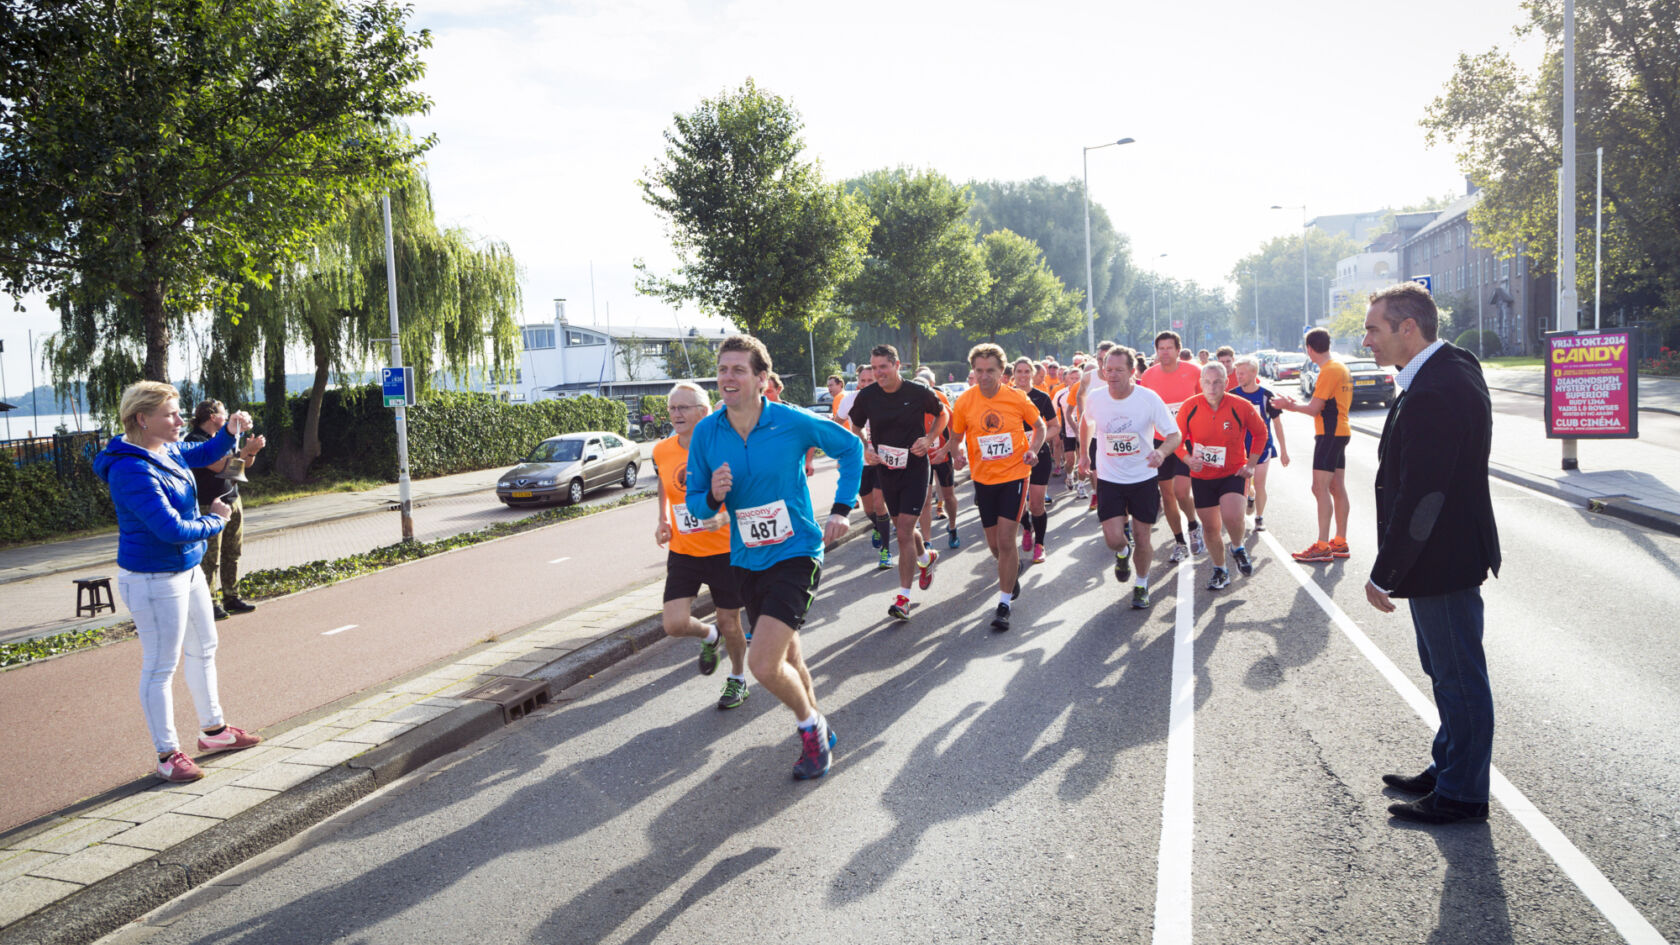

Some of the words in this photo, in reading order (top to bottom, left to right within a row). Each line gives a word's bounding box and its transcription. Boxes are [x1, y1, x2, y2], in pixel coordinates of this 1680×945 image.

[1575, 338, 1581, 347] 3
[1552, 346, 1624, 364] CANDY
[383, 369, 391, 382] P
[1557, 376, 1619, 385] DIAMONDSPIN
[1593, 382, 1622, 391] GUEST
[1565, 391, 1610, 399] SUPERIOR
[1556, 419, 1578, 427] CLUB
[1580, 416, 1620, 426] CINÉMA
[987, 442, 1005, 456] 477
[1113, 441, 1132, 453] 496
[1202, 452, 1218, 463] 34
[750, 518, 777, 540] 487
